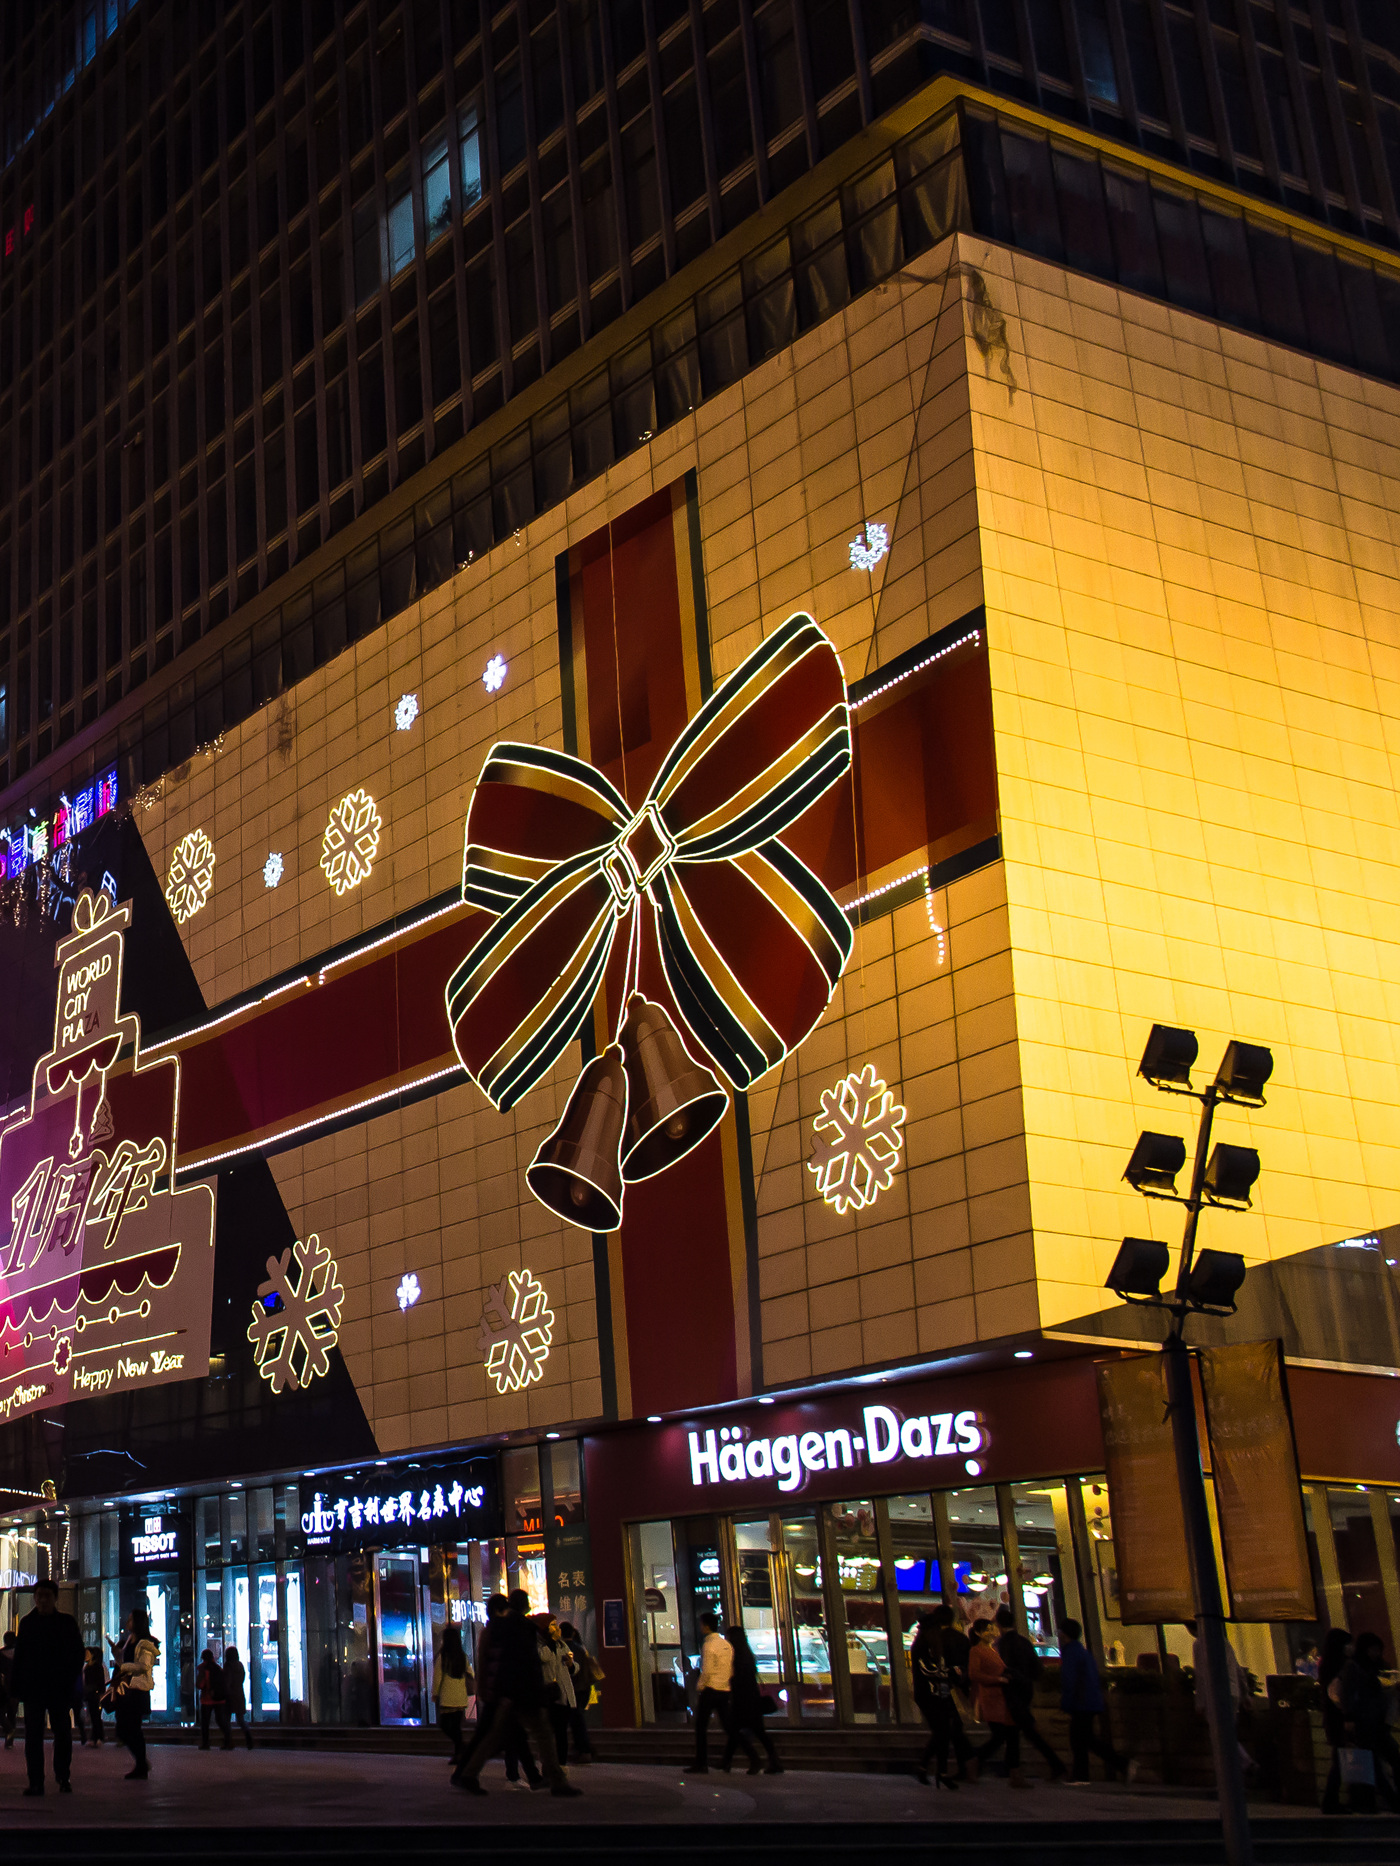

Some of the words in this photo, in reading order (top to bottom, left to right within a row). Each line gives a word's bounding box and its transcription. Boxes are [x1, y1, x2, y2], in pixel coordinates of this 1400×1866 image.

[67, 953, 112, 994] WORLD
[64, 987, 91, 1020] CITY
[73, 1366, 113, 1391] Happy
[117, 1357, 149, 1379] New
[150, 1350, 185, 1374] Year
[688, 1404, 984, 1492] Häagen-Dazs
[131, 1532, 176, 1555] TISSOT
[558, 1570, 586, 1588] 名表
